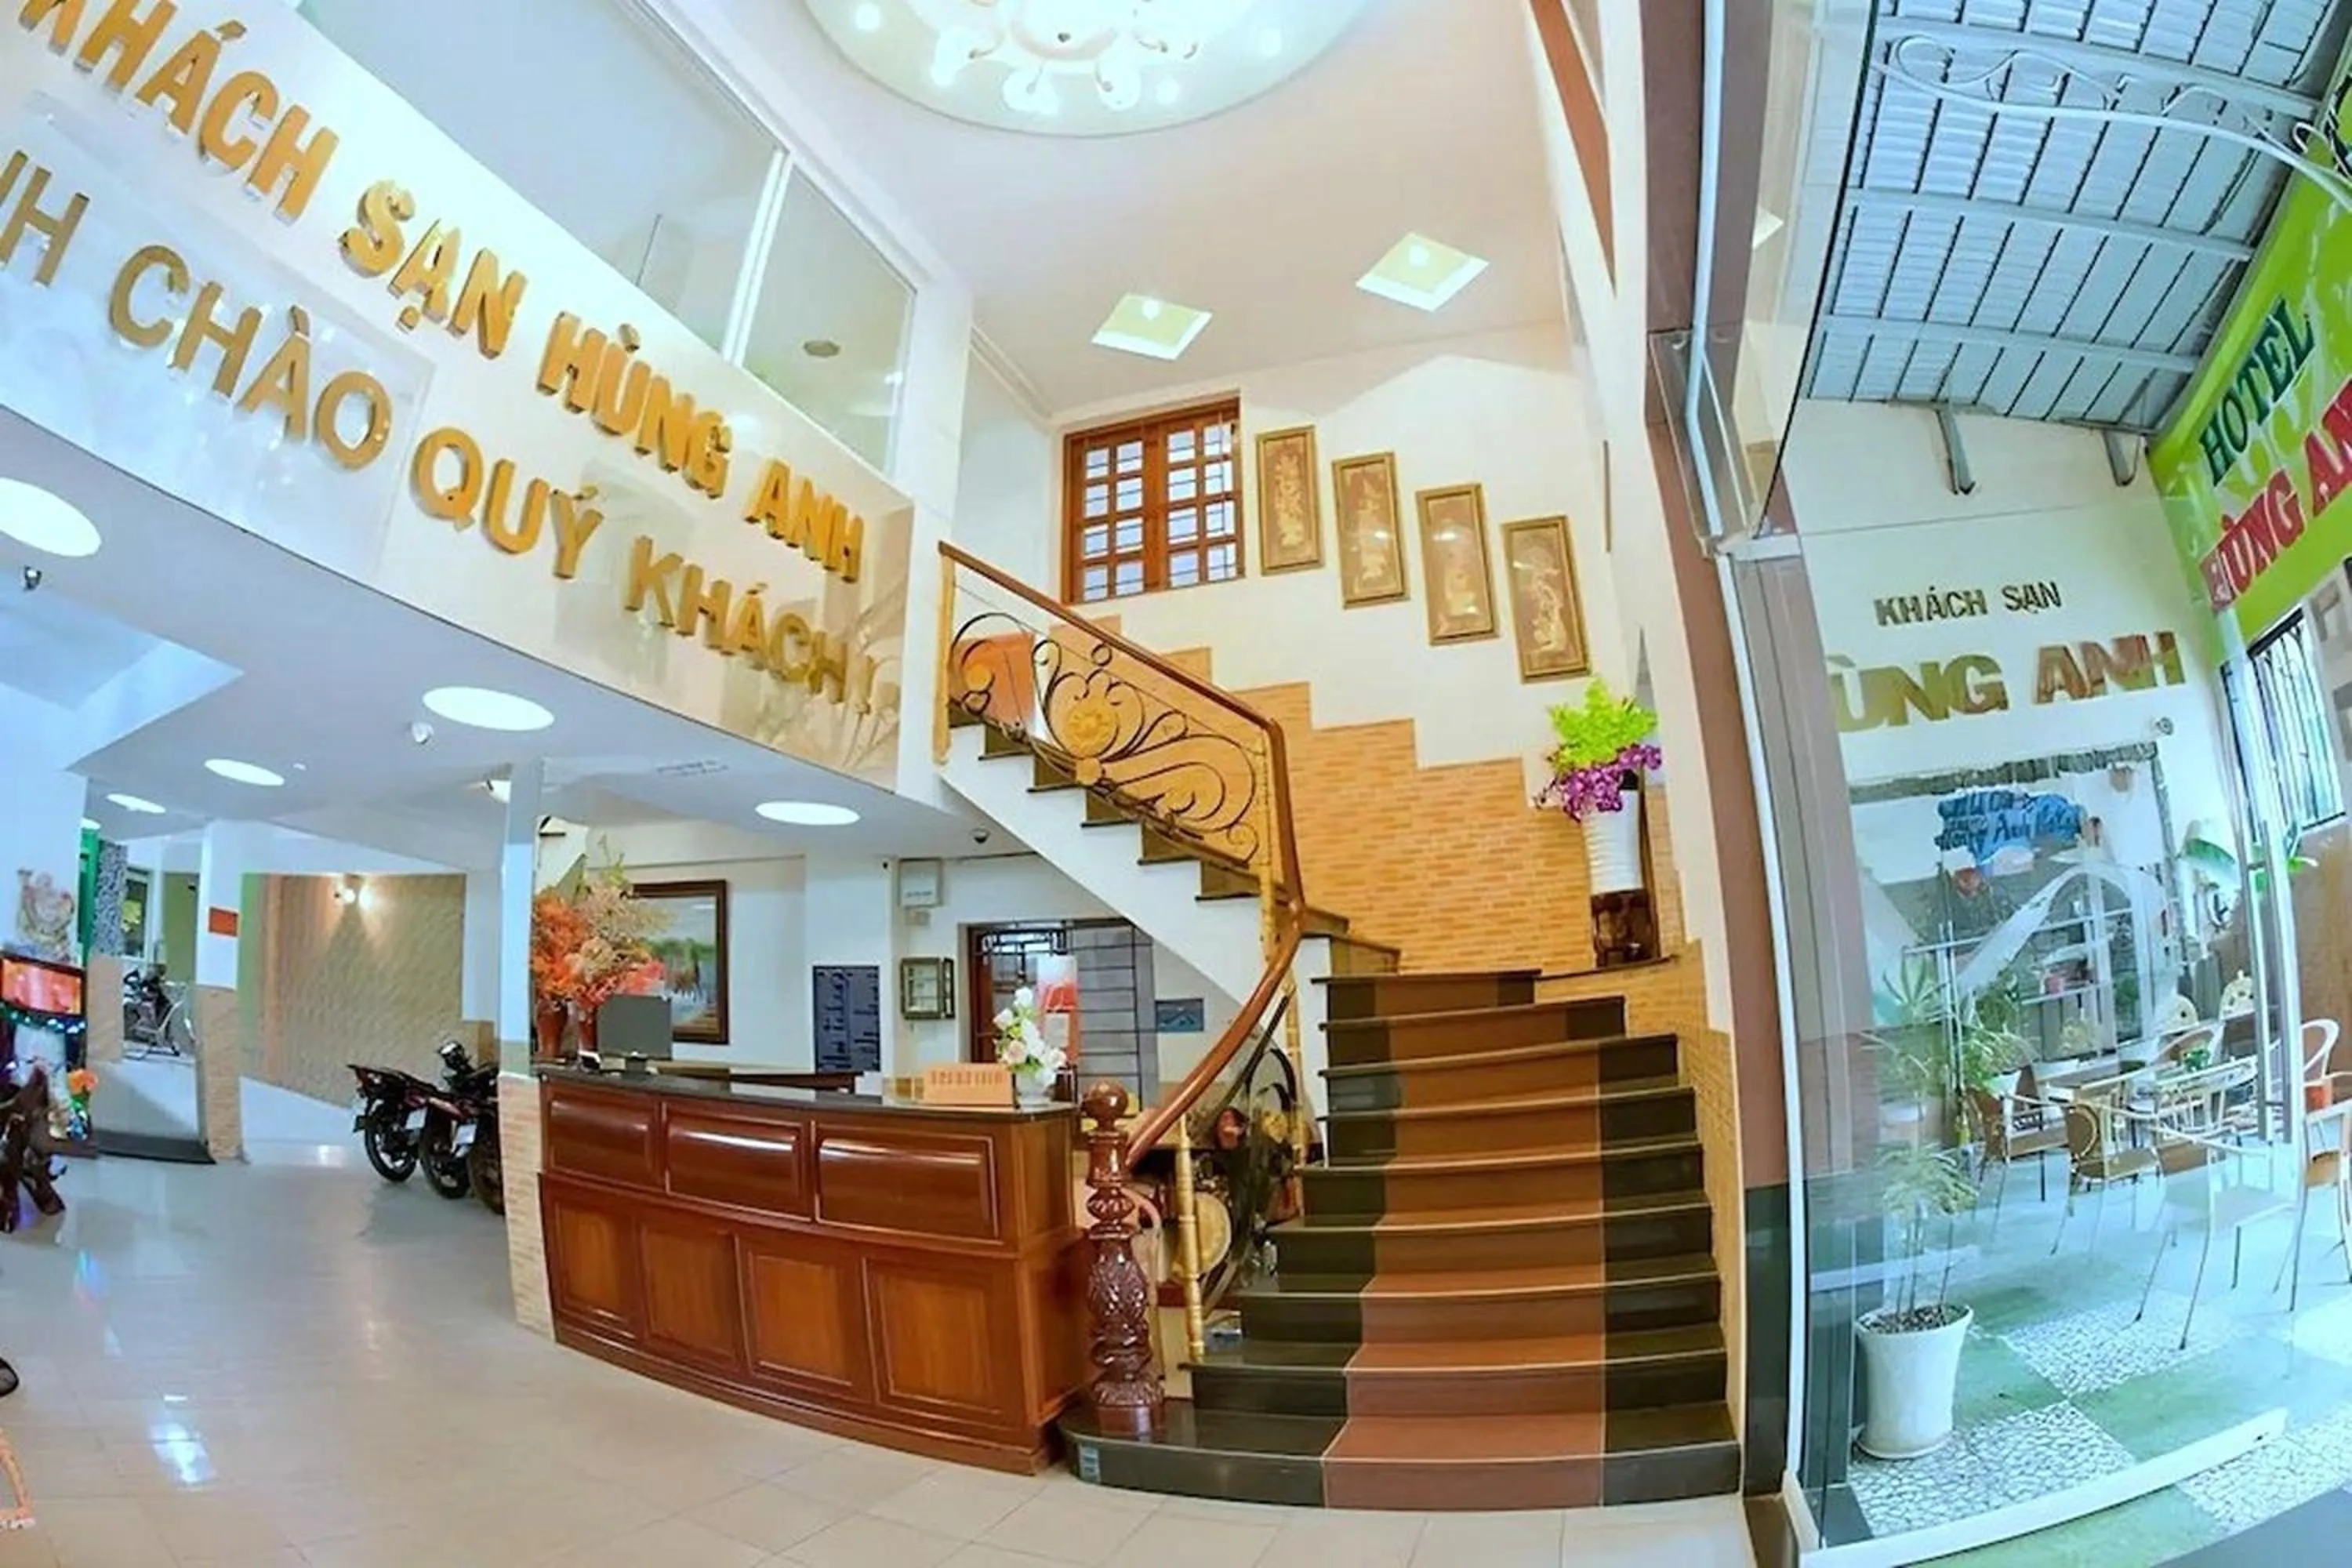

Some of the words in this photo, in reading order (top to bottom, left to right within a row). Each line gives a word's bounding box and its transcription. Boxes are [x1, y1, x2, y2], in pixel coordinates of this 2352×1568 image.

[107, 245, 392, 470] CHÀO
[411, 427, 604, 579] QUÝ
[338, 180, 527, 360] SẠN
[536, 311, 732, 499] HÙNG
[745, 459, 864, 583] ANH
[2199, 296, 2315, 488] HOTEL
[1874, 584, 1988, 626] KHÁCH
[2002, 581, 2062, 613] SẠN
[2033, 631, 2185, 705] ANH
